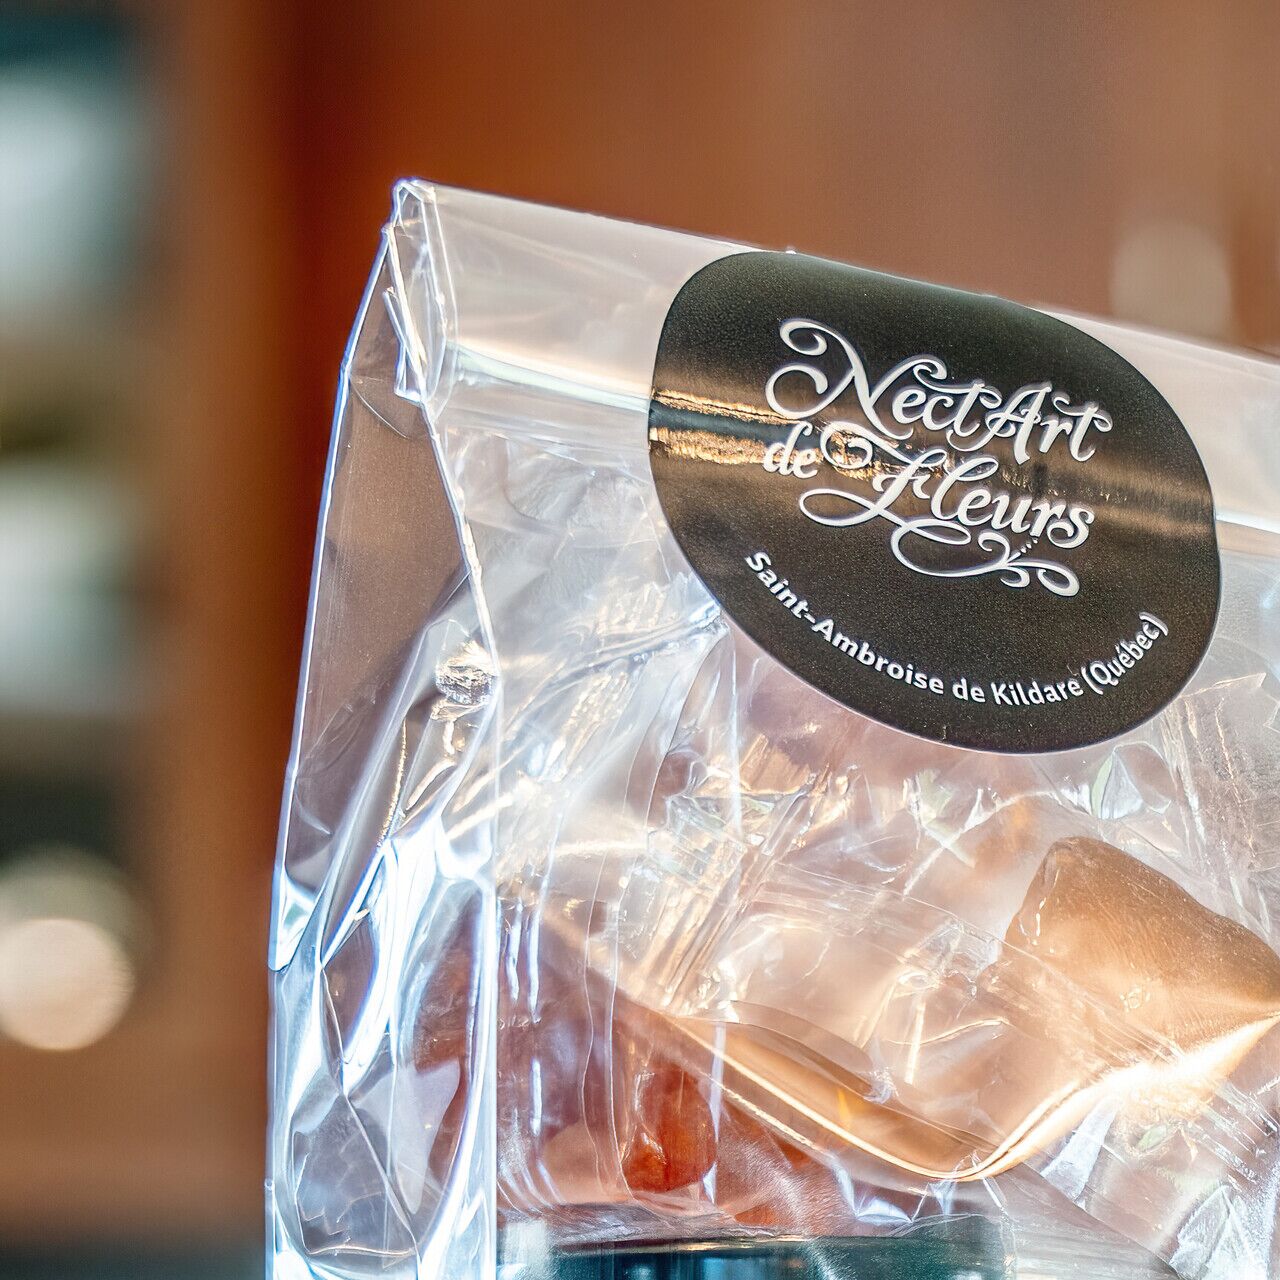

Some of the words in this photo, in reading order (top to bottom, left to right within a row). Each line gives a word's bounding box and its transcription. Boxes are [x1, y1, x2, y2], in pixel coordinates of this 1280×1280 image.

[765, 319, 1113, 464] NectArt
[763, 421, 821, 479] de
[800, 421, 1095, 552] Fleurs
[745, 550, 945, 696] Saint-Ambroise
[952, 677, 986, 704] de
[992, 679, 1084, 706] Kildare
[1080, 610, 1169, 695] (Québec)
